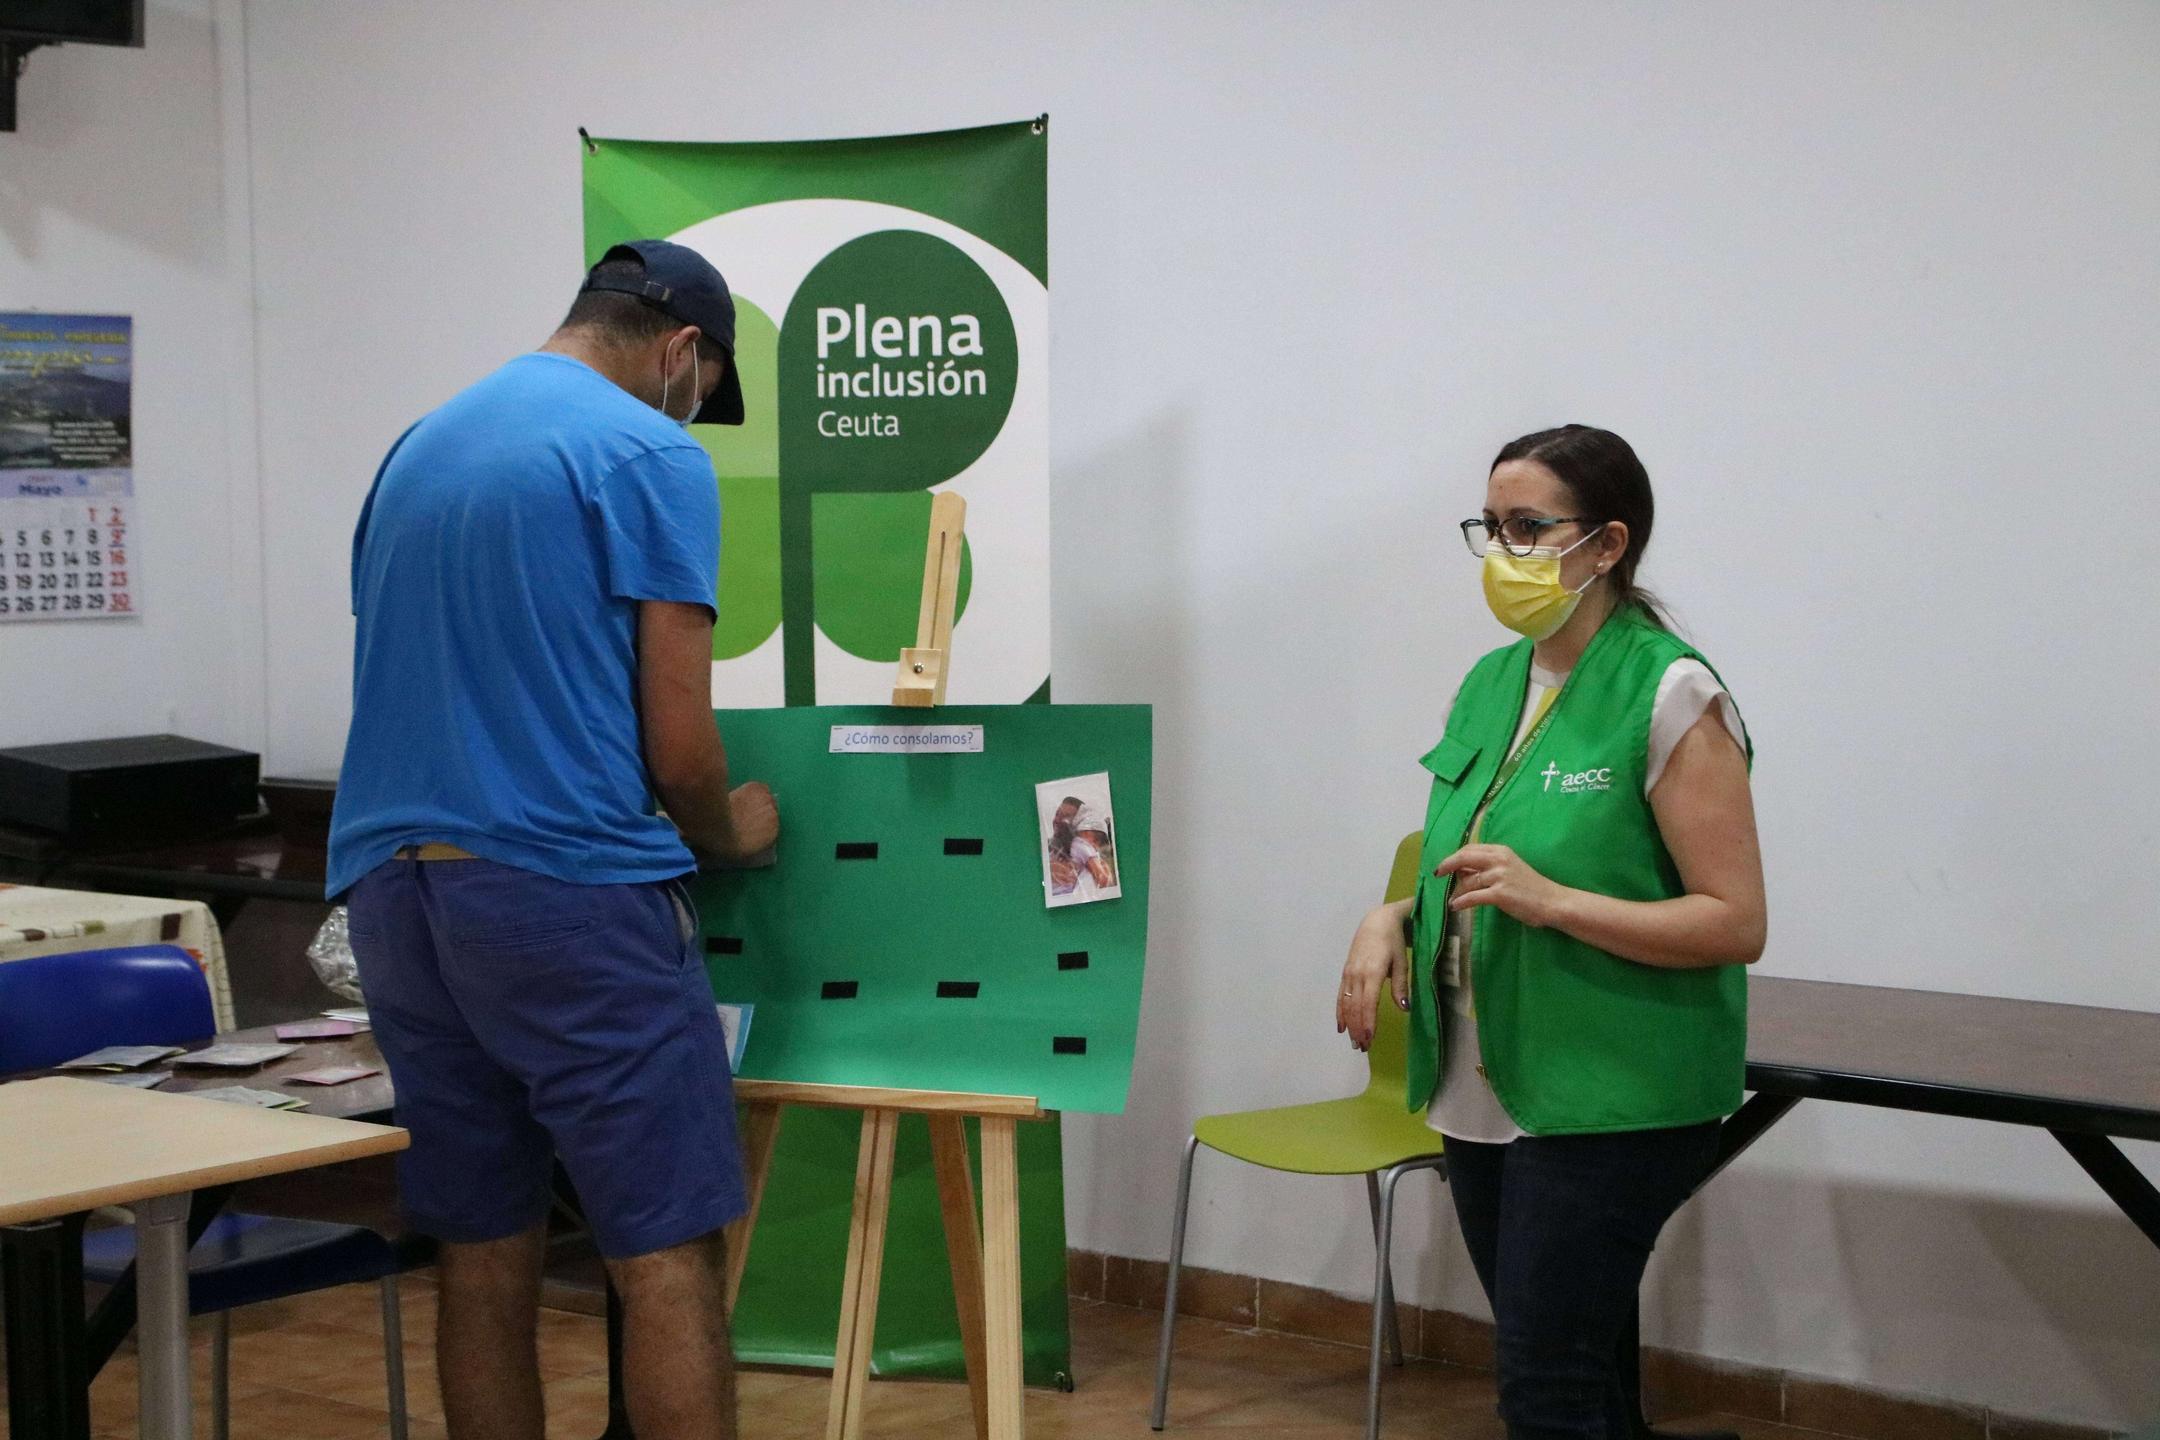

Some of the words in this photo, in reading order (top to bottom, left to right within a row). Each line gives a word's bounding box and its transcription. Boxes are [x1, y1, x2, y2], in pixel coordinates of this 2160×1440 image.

[817, 304, 983, 358] Plena
[816, 360, 987, 398] inclusión
[817, 411, 900, 436] Ceuta
[17, 530, 27, 546] 5
[41, 530, 52, 545] 6
[65, 529, 74, 545] 7
[87, 529, 98, 544] 8
[15, 553, 31, 568] 12
[39, 552, 55, 567] 13
[62, 551, 79, 566] 14
[86, 550, 101, 565] 15
[15, 574, 32, 589] 19
[38, 574, 58, 589] 20
[64, 573, 79, 589] 21
[86, 572, 103, 588] 22
[15, 597, 34, 612] 26
[40, 595, 58, 611] 27
[63, 595, 82, 610] 28
[86, 594, 105, 609] 29
[845, 731, 889, 746] ¿Cómo
[893, 731, 974, 745] consolamos?
[1561, 768, 1611, 786] aecc
